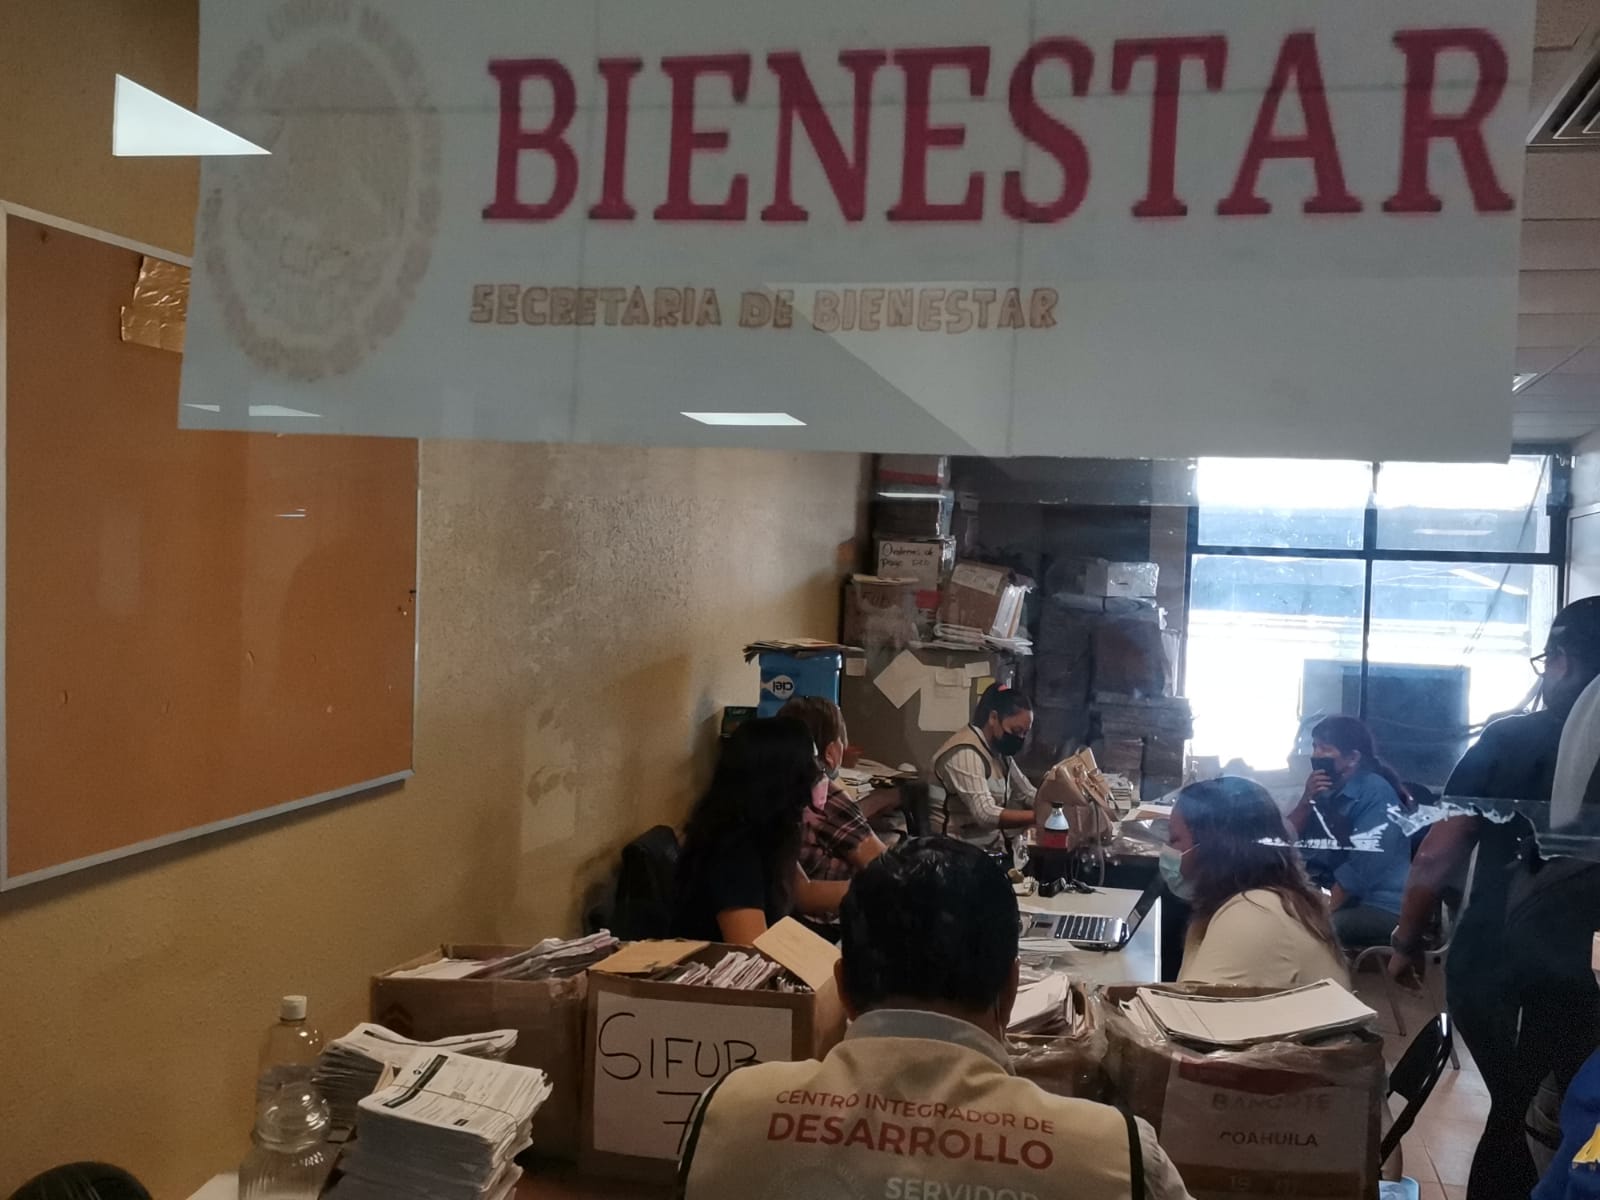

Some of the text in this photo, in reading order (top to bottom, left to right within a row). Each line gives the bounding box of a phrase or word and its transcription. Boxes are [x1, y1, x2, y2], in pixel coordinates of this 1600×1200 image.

[481, 28, 1515, 224] BIENESTAR
[469, 284, 1058, 334] SECRETARIA DE BIENESTAR
[776, 1090, 1054, 1134] CENTRO INTEGRADOR DE
[767, 1112, 1054, 1170] DESARROLLO
